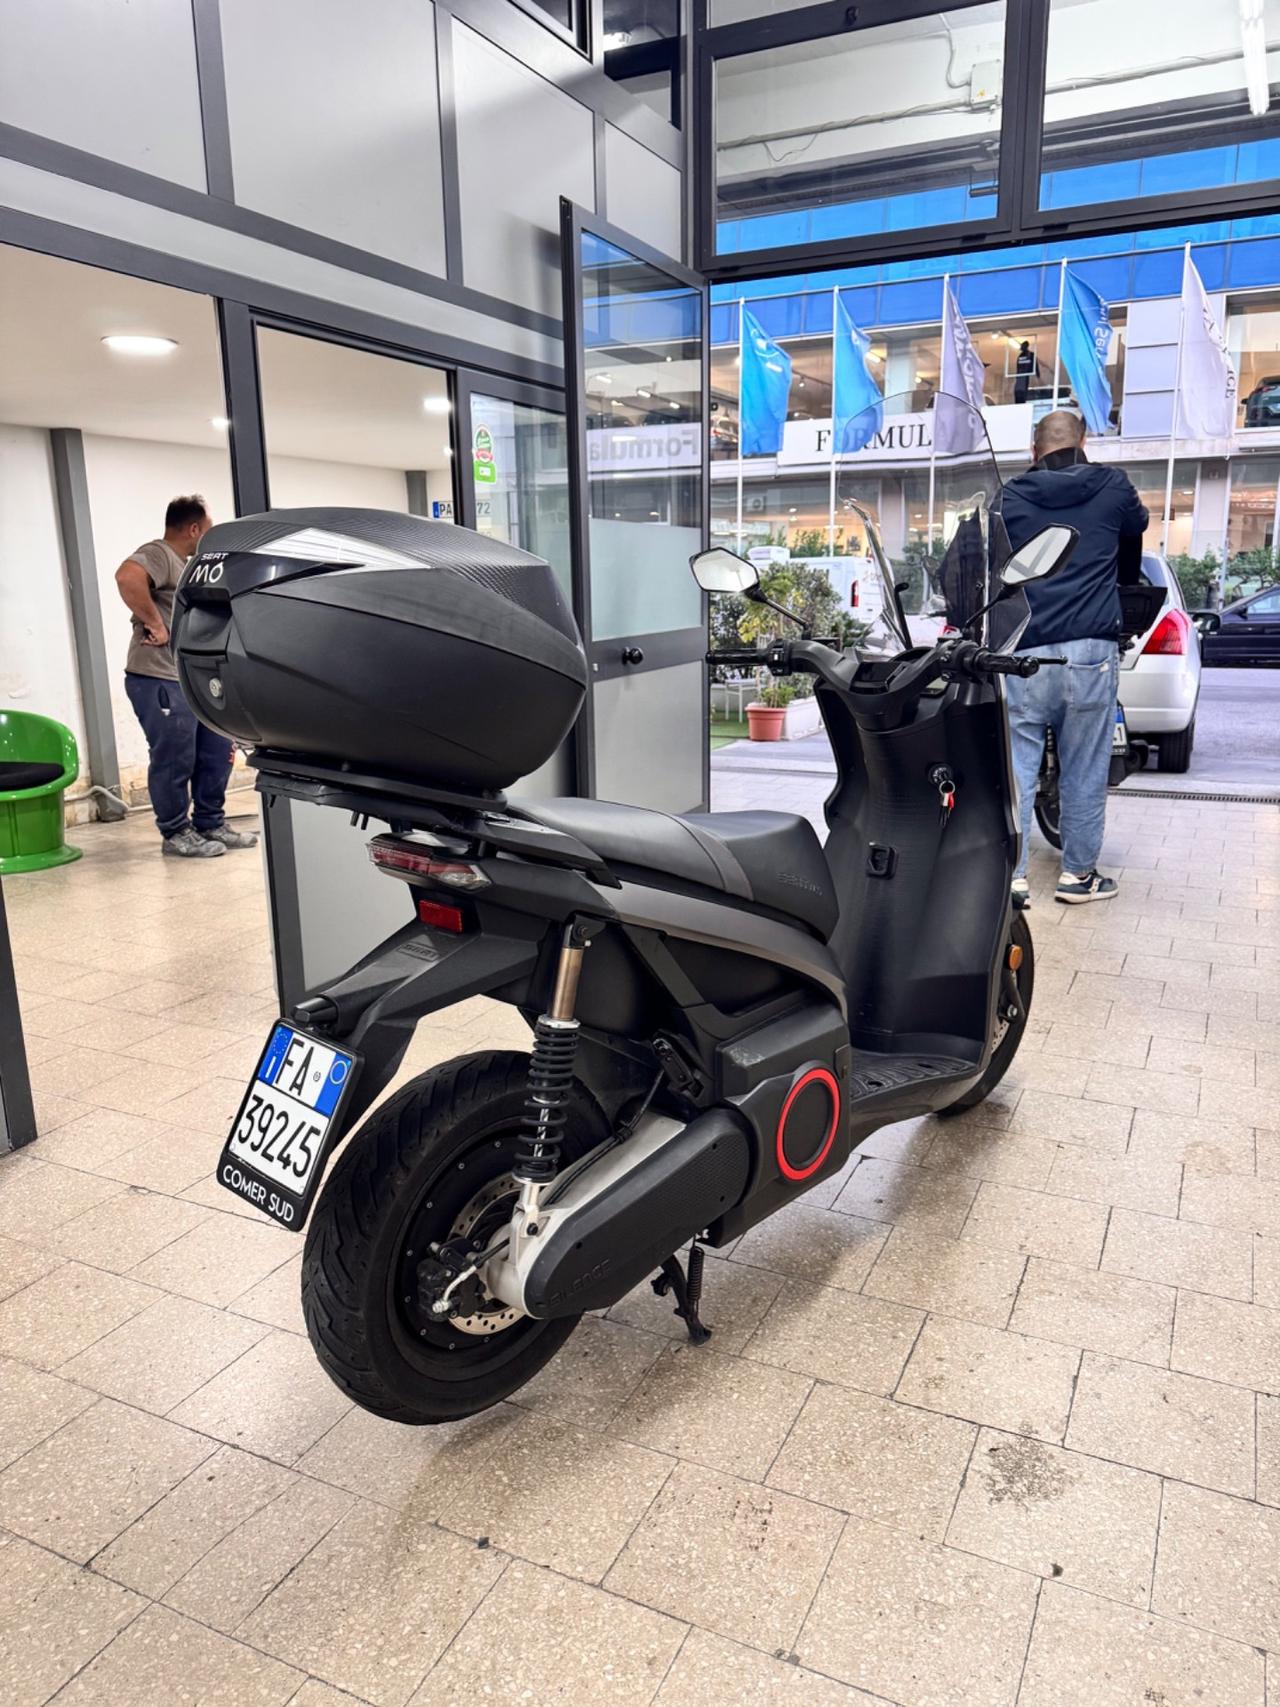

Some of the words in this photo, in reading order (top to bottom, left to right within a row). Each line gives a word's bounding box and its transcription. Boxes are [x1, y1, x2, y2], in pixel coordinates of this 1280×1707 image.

[816, 423, 988, 452] FORMUL
[201, 552, 230, 561] SEAT
[275, 1037, 315, 1097] FA
[237, 1094, 321, 1178] 39245
[222, 1165, 267, 1205] COMER
[268, 1193, 295, 1222] SUD
